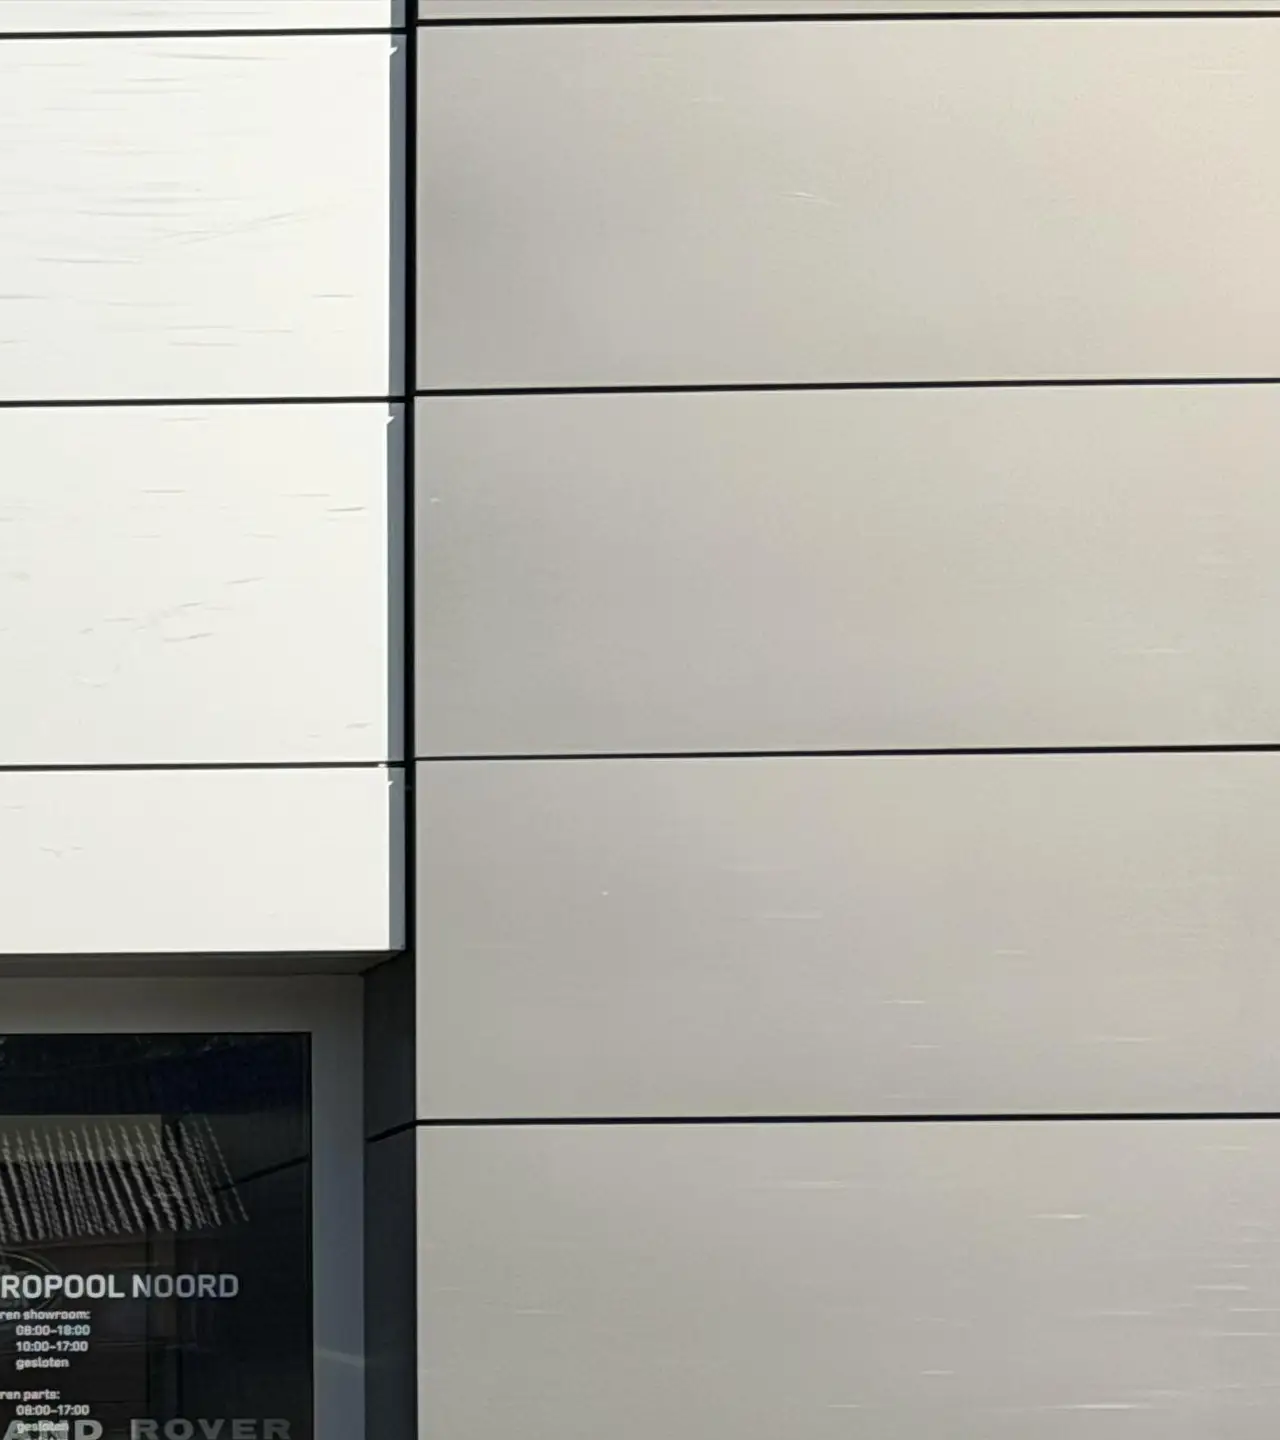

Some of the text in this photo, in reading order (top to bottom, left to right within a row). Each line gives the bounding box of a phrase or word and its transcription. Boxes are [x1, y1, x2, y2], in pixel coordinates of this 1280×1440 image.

[132, 1274, 239, 1298] NOORD
[23, 1309, 91, 1321] showroom:
[16, 1357, 70, 1370] gesloten
[23, 1389, 60, 1401] parts:
